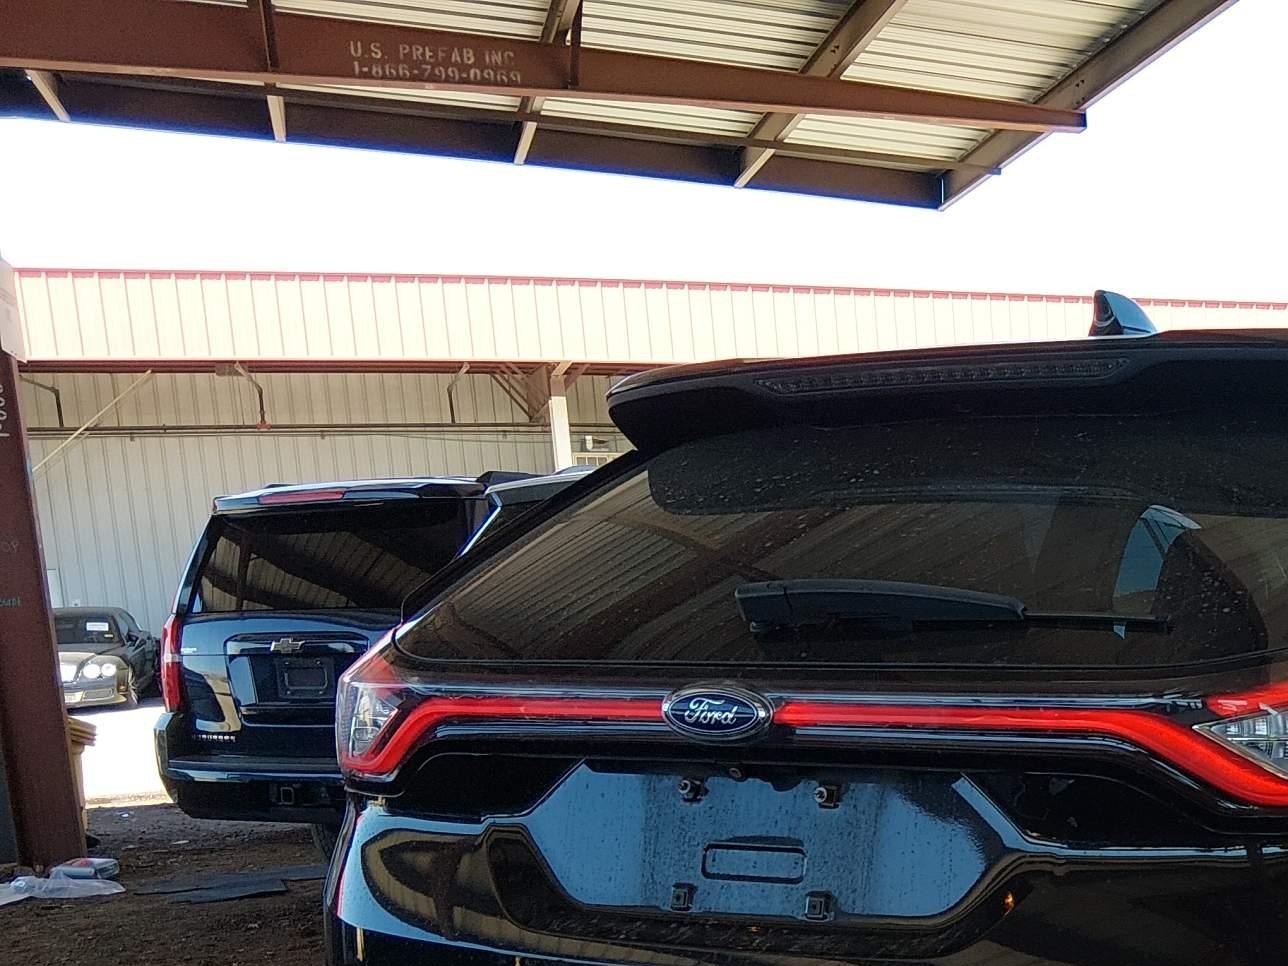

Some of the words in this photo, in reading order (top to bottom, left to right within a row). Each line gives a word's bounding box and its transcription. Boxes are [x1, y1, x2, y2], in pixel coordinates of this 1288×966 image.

[349, 40, 388, 60] U.S.
[399, 44, 475, 65] PREFAB
[352, 60, 521, 85] 1-866-799-0969
[684, 697, 739, 726] Ford
